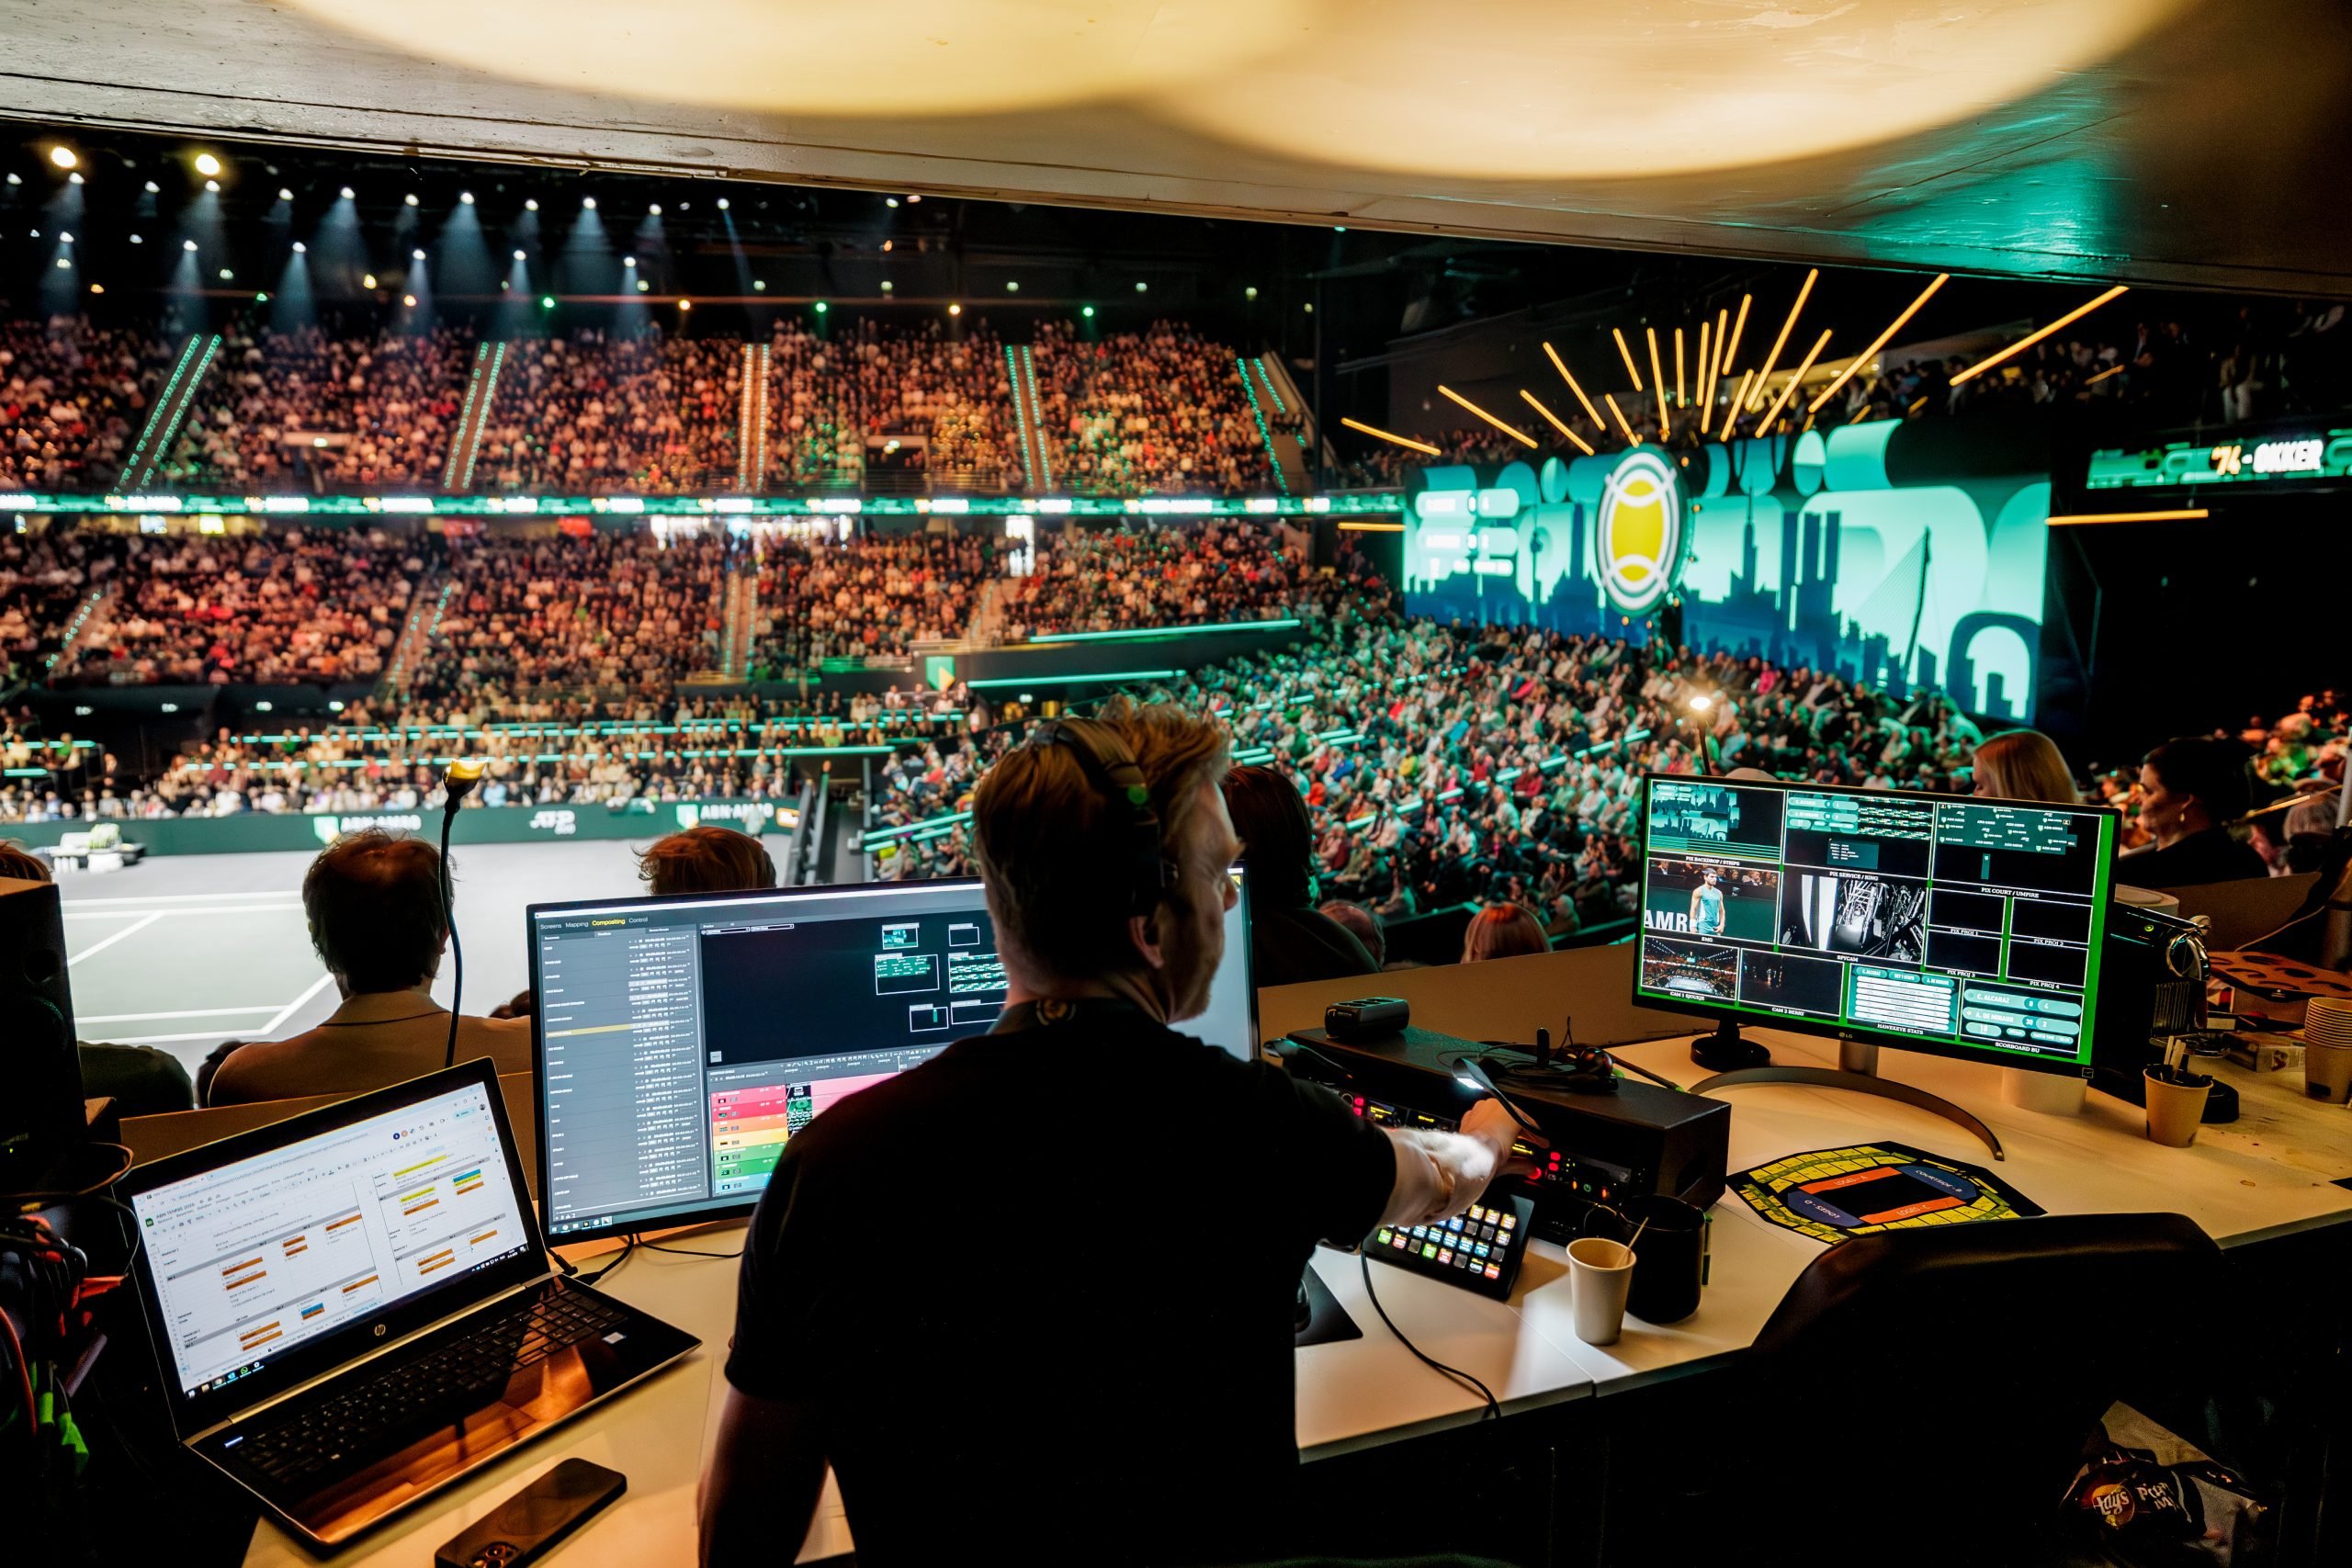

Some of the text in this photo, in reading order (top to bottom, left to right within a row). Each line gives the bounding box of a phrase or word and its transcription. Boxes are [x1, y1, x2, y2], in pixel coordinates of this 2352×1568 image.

[2253, 439, 2324, 473] OKKER
[2016, 890, 2040, 898] UMPIRE
[1644, 909, 1697, 933] AMR
[1984, 995, 2009, 1004] ALCARAZ
[1991, 1014, 2014, 1022] MINAUR
[1996, 1042, 2030, 1053] SCORBOARD
